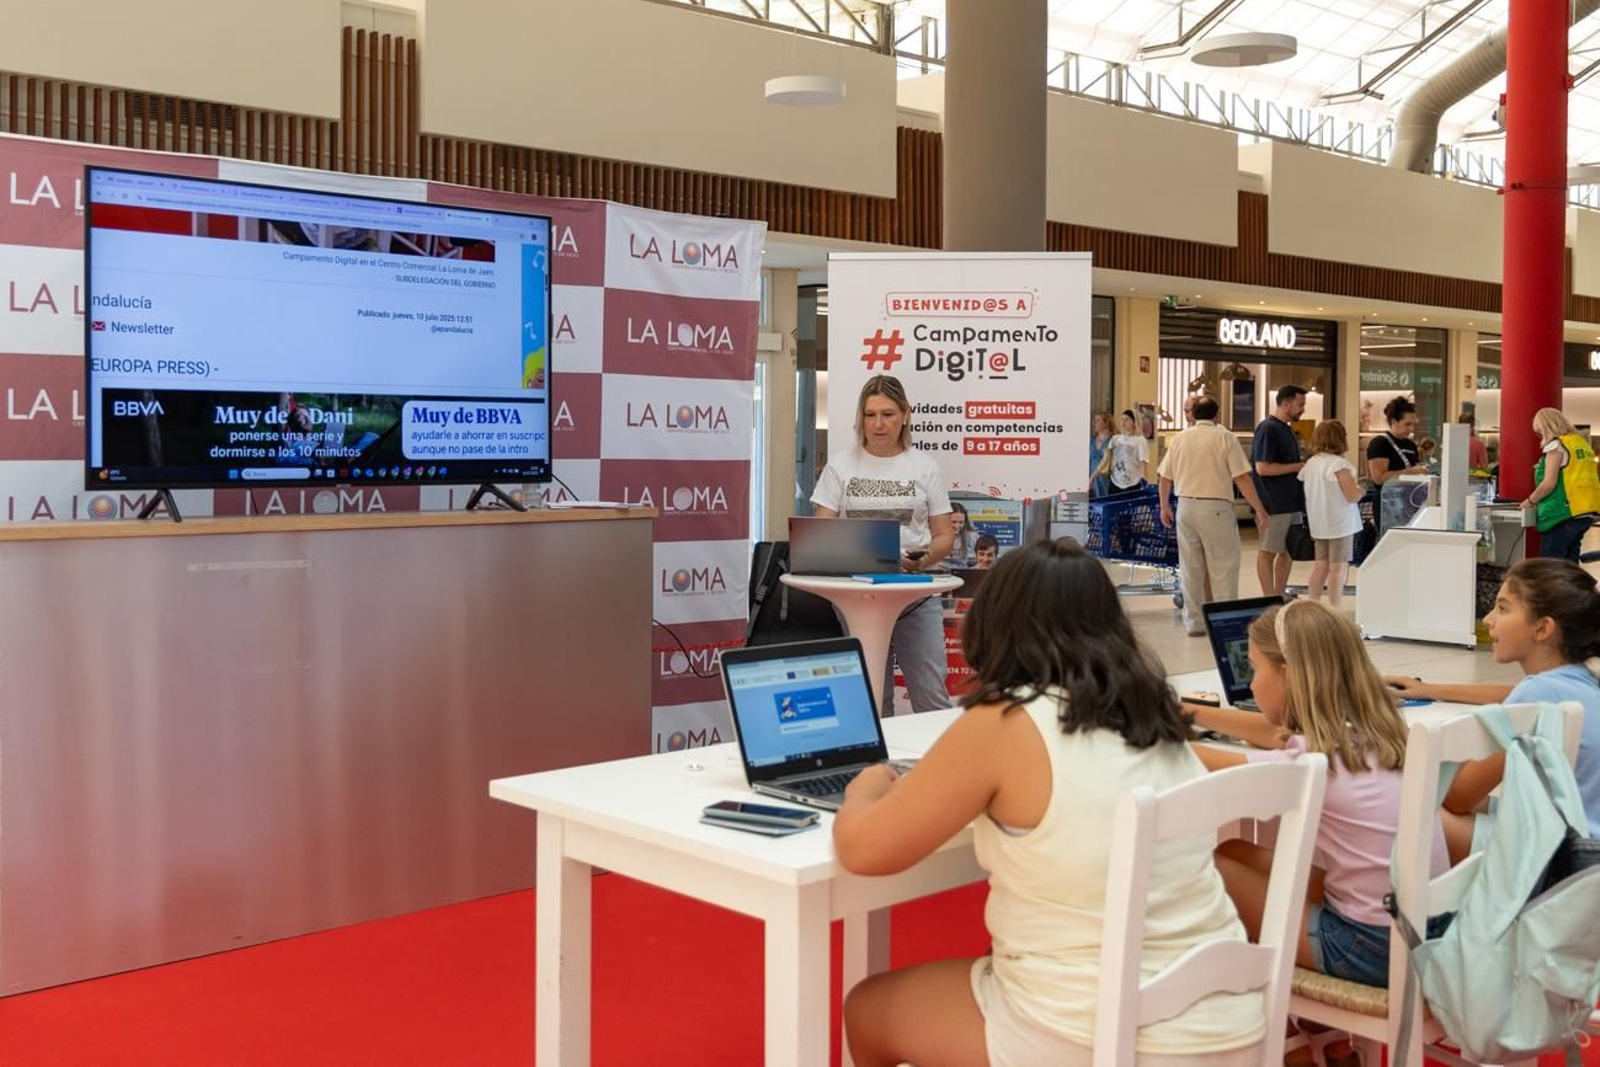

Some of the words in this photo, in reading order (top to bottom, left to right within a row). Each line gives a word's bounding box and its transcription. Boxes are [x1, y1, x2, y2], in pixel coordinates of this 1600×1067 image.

[10, 172, 61, 208] LA
[630, 234, 662, 262] LA
[672, 240, 738, 269] LOMA
[283, 251, 333, 264] Campamento
[335, 255, 358, 266] Digital
[370, 258, 377, 267] el
[378, 259, 400, 269] Centro
[403, 261, 437, 271] Comercial
[438, 264, 447, 272] La
[448, 265, 467, 274] Loma
[468, 266, 477, 275] de
[450, 279, 462, 287] DEL
[463, 280, 496, 289] GOBIERNO
[9, 281, 59, 315] LA
[892, 298, 1008, 312] BIENVENID@S
[1016, 299, 1026, 311] A
[111, 321, 174, 335] Newsletter
[425, 313, 438, 322] julio
[440, 314, 455, 322] 2025
[627, 317, 659, 345] LA
[667, 321, 734, 350] LOMA
[1219, 318, 1296, 349] BEDLAND
[91, 357, 153, 373] EUROPA
[157, 360, 210, 378] PRESS)
[8, 388, 58, 420] LA
[114, 401, 165, 416] BBVA
[968, 403, 1033, 418] gratuitas
[214, 405, 261, 428] Muy
[264, 407, 288, 424] de
[309, 407, 354, 426] Dani
[411, 407, 451, 428] Muy
[453, 407, 474, 424] de
[476, 408, 522, 424] BBVA
[626, 402, 658, 428] LA
[666, 404, 730, 430] LOMA
[230, 432, 279, 443] ponerse
[282, 432, 304, 441] una
[306, 430, 334, 441] serie
[336, 432, 344, 442] y
[411, 430, 452, 442] ayudarle
[461, 431, 494, 440] ahorrar
[496, 432, 508, 440] en
[946, 424, 962, 432] en
[965, 422, 1063, 436] competencias
[210, 446, 266, 458] dormirse
[268, 448, 275, 457] a
[278, 446, 295, 458] los
[299, 446, 312, 457] 10
[315, 446, 362, 458] minutos
[411, 446, 446, 455] aunque
[448, 446, 460, 454] no
[462, 446, 483, 455] pase
[485, 445, 497, 454] de
[498, 445, 506, 454] la
[508, 445, 528, 454] intro
[941, 440, 958, 451] de
[966, 440, 974, 451] 9
[977, 442, 986, 451] a
[988, 440, 1001, 451] 17
[1003, 440, 1037, 451] años
[624, 486, 655, 508] LA
[663, 486, 728, 511] LOMA
[662, 567, 726, 593] LOMA
[660, 648, 722, 676] LOMA
[657, 727, 722, 754] LOMA
